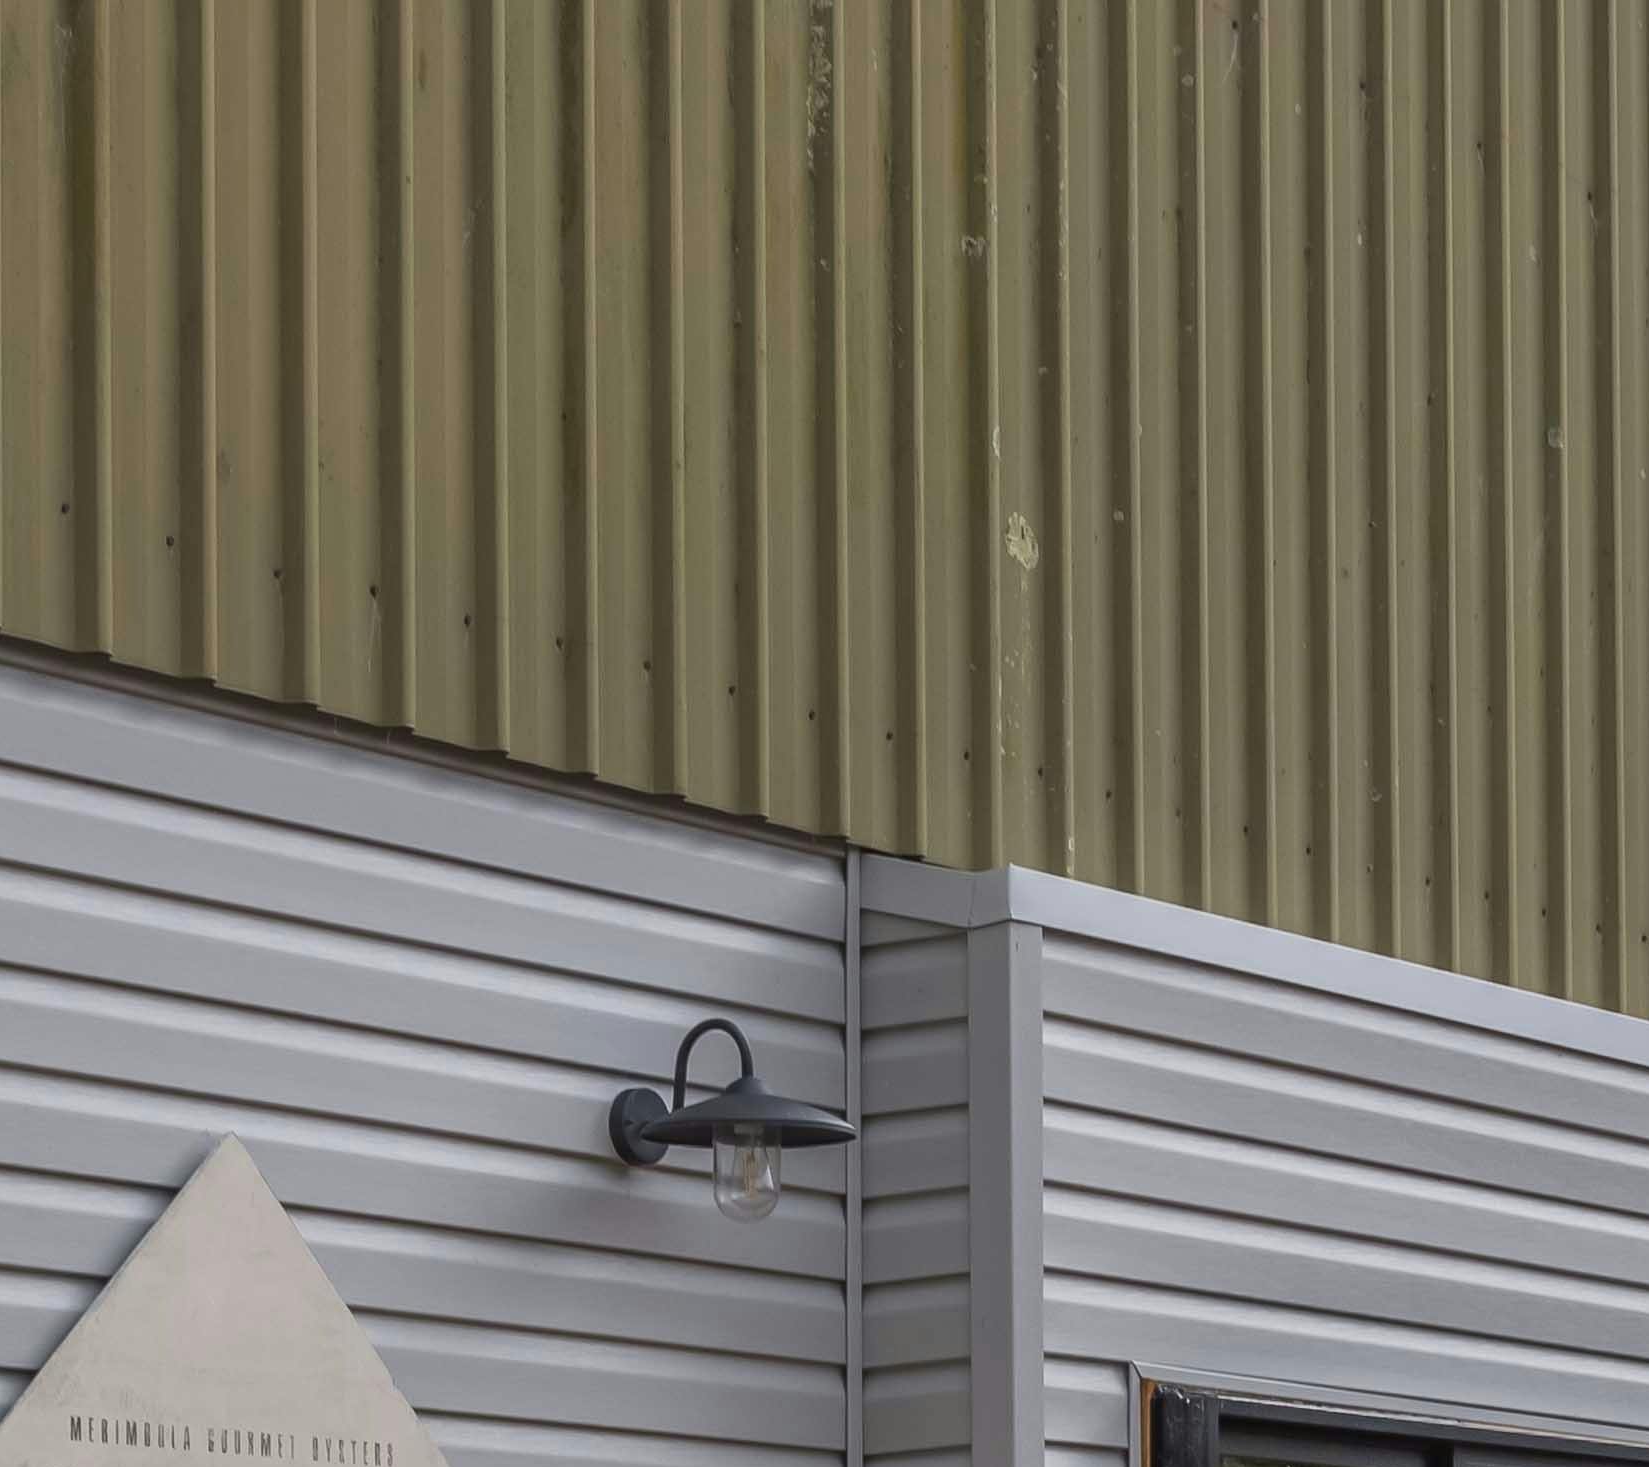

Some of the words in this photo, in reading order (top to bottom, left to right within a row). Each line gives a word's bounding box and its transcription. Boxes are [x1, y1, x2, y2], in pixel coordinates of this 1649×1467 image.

[69, 1415, 191, 1451] MERIMBULA
[207, 1428, 295, 1460] GOURMET
[312, 1436, 394, 1467] OYSTERS
